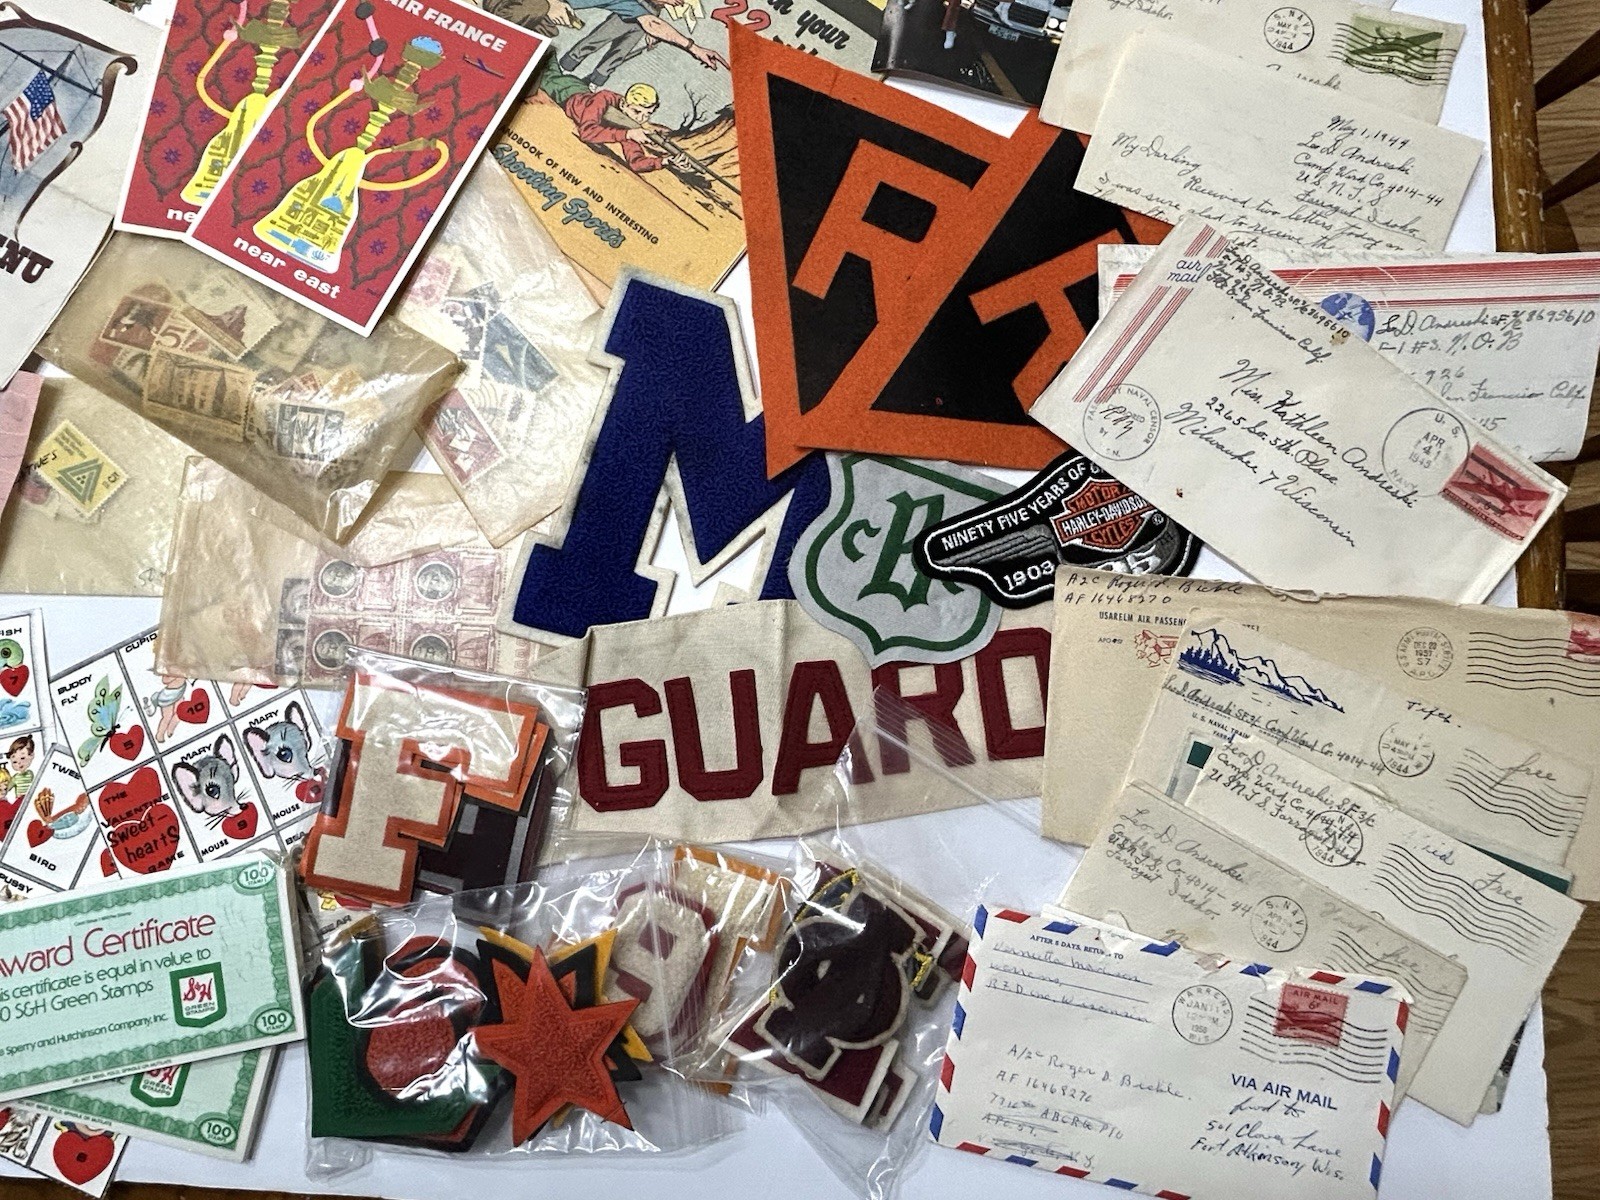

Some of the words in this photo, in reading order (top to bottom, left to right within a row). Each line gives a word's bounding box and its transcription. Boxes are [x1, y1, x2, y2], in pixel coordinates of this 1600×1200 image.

[423, 8, 507, 52] FRANCE
[795, 10, 849, 50] your
[1111, 132, 1141, 157] My
[1140, 135, 1202, 176] Darling
[493, 143, 567, 211] Shooting
[562, 198, 626, 248] Sports
[546, 158, 558, 169] OF
[559, 168, 582, 187] NEW
[582, 186, 604, 203] AND
[605, 202, 659, 245] INTERESTING
[233, 235, 286, 270] near
[293, 269, 341, 299] east
[1167, 263, 1212, 282] mail
[1176, 259, 1202, 272] air
[1127, 388, 1153, 407] NAVAL
[1143, 410, 1158, 444] CENSOR
[1205, 396, 1246, 426] 2265
[1263, 390, 1337, 455] Kathleen
[1341, 446, 1419, 509] Andreski
[1421, 432, 1446, 448] APR
[1164, 401, 1260, 474] Milwaukee
[1273, 474, 1356, 548] Wisconsin
[941, 519, 994, 552] NINETY
[998, 507, 1031, 531] FIVE
[1027, 476, 1070, 521] YEARS
[1067, 461, 1087, 481] OF
[1091, 518, 1136, 545] CYCLES
[1003, 560, 1055, 591] 1903
[1099, 611, 1134, 623] USARELM
[1138, 614, 1151, 624] AIR
[0, 627, 22, 636] ISH
[125, 632, 158, 653] CUPID
[10, 675, 19, 685] 7
[57, 674, 93, 695] BUDDY
[61, 694, 79, 706] FLY
[187, 703, 205, 714] 10
[248, 709, 280, 728] MARY
[577, 627, 1052, 812] GUARD
[1209, 719, 1228, 731] NAVAL
[180, 744, 213, 762] MARY
[104, 791, 128, 804] THE
[101, 793, 170, 829] VALENTINE
[272, 803, 301, 820] MOUSE
[200, 839, 230, 856] MOUSE
[29, 853, 57, 871] BIRD
[243, 866, 269, 882] 100
[83, 914, 216, 958] Certificate
[1030, 934, 1053, 945] AFTER
[1083, 945, 1111, 957] RETU
[12, 972, 82, 999] certificate
[84, 970, 94, 984] is
[96, 959, 137, 982] equal
[139, 959, 152, 973] in
[154, 952, 193, 969] value
[196, 948, 211, 961] to
[15, 998, 47, 1019] S&H
[51, 991, 98, 1011] Green
[101, 979, 154, 1001] Stamps
[184, 1001, 216, 1012] GREEN
[1186, 1000, 1208, 1012] JAN
[1293, 989, 1312, 999] AIR
[1314, 993, 1338, 1005] MAIL
[185, 1007, 216, 1017] STAMPS
[261, 1013, 288, 1028] 100
[6, 1039, 37, 1057] Sperry
[37, 1035, 56, 1048] and
[56, 1026, 107, 1044] Hutchinson
[153, 1013, 169, 1026] Inc.
[142, 1085, 171, 1096] STAMPS
[143, 1079, 173, 1091] GREEN
[1231, 1073, 1257, 1090] VIA
[1263, 1082, 1291, 1098] AIR
[1296, 1089, 1338, 1111] MAIL
[206, 1122, 232, 1138] 100
[1190, 1137, 1230, 1151] Fort
